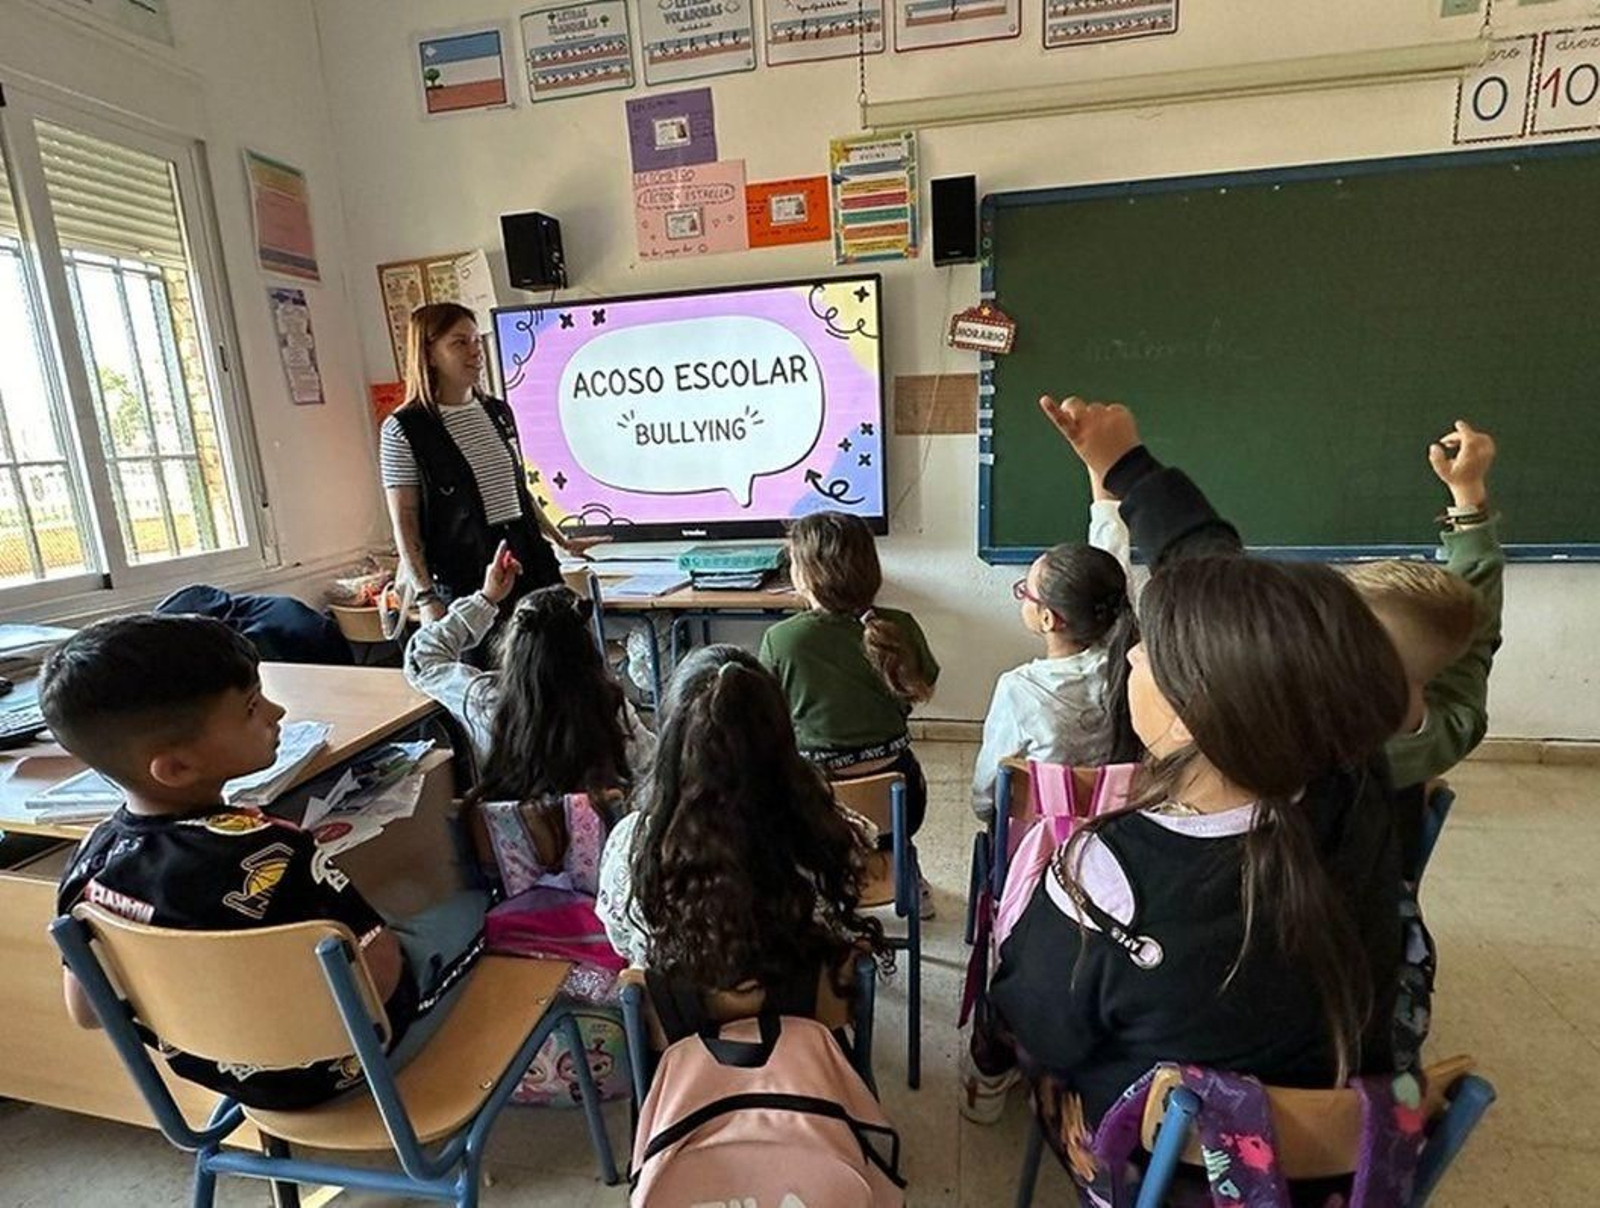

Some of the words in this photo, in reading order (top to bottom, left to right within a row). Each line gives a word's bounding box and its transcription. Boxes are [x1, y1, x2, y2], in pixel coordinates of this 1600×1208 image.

[1473, 76, 1508, 121] 0
[1542, 63, 1599, 108] 10
[958, 327, 1006, 343] HORARIO
[573, 366, 663, 399] ACOSO
[675, 354, 808, 391] ESCOLAR
[635, 417, 747, 446] BULLYING
